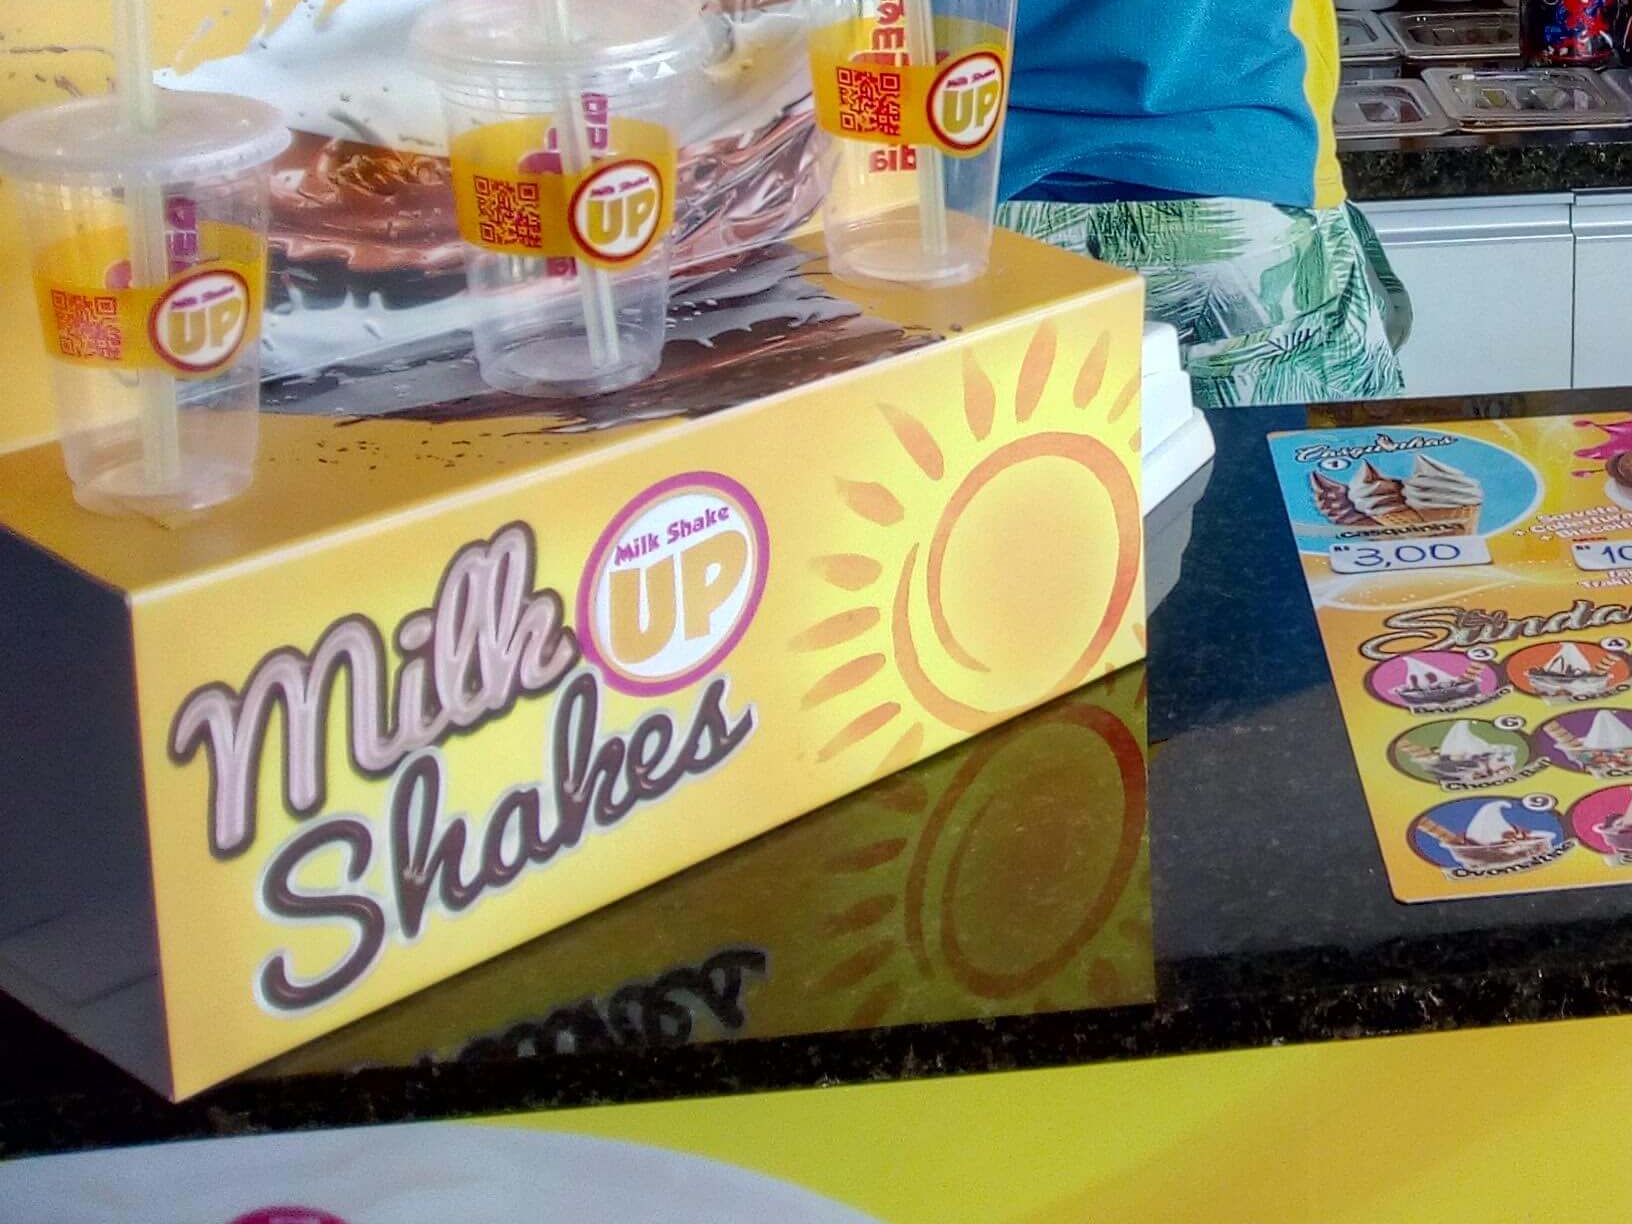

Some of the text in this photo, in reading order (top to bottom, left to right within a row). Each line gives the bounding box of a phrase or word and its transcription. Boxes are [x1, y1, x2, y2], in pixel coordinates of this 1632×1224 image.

[941, 81, 999, 135] UP
[587, 187, 657, 246] UP
[167, 295, 242, 355] UP
[614, 504, 730, 566] Milk Shake
[1353, 543, 1461, 568] 3,00
[608, 529, 749, 666] UP
[168, 520, 577, 861] Milk
[258, 672, 757, 1012] Shakes
